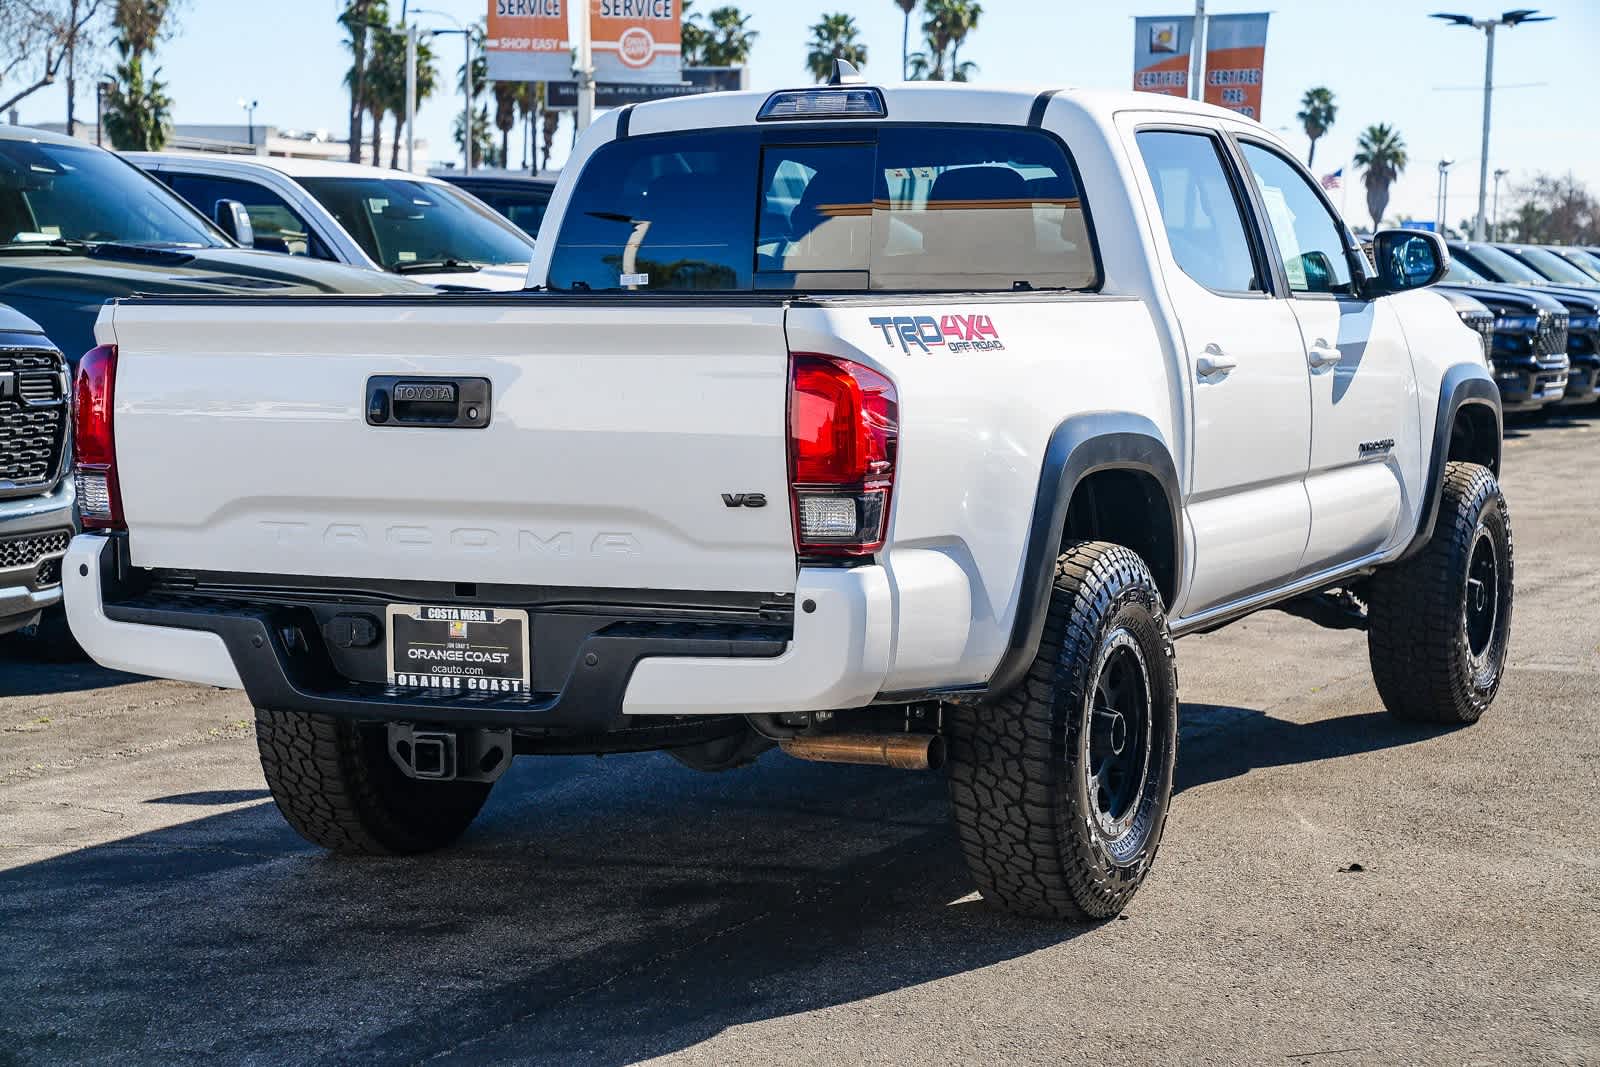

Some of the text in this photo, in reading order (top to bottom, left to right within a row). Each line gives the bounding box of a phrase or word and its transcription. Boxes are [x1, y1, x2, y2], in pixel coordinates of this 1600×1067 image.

[497, 0, 561, 17] SERVICE
[601, 0, 673, 18] SERVICE
[501, 39, 559, 49] SHOP EASY
[1136, 72, 1186, 87] CERTIFIED
[1208, 69, 1261, 86] CERTIFIED
[869, 315, 999, 356] TRD 4X4
[948, 340, 1005, 354] OFF ROAD
[398, 387, 451, 400] TOYOTA
[720, 493, 767, 508] V6
[257, 520, 642, 559] TACOMA
[428, 608, 487, 621] COSTA MESA
[431, 665, 484, 676] ocauto.com
[398, 674, 520, 692] ORANGE COAST
